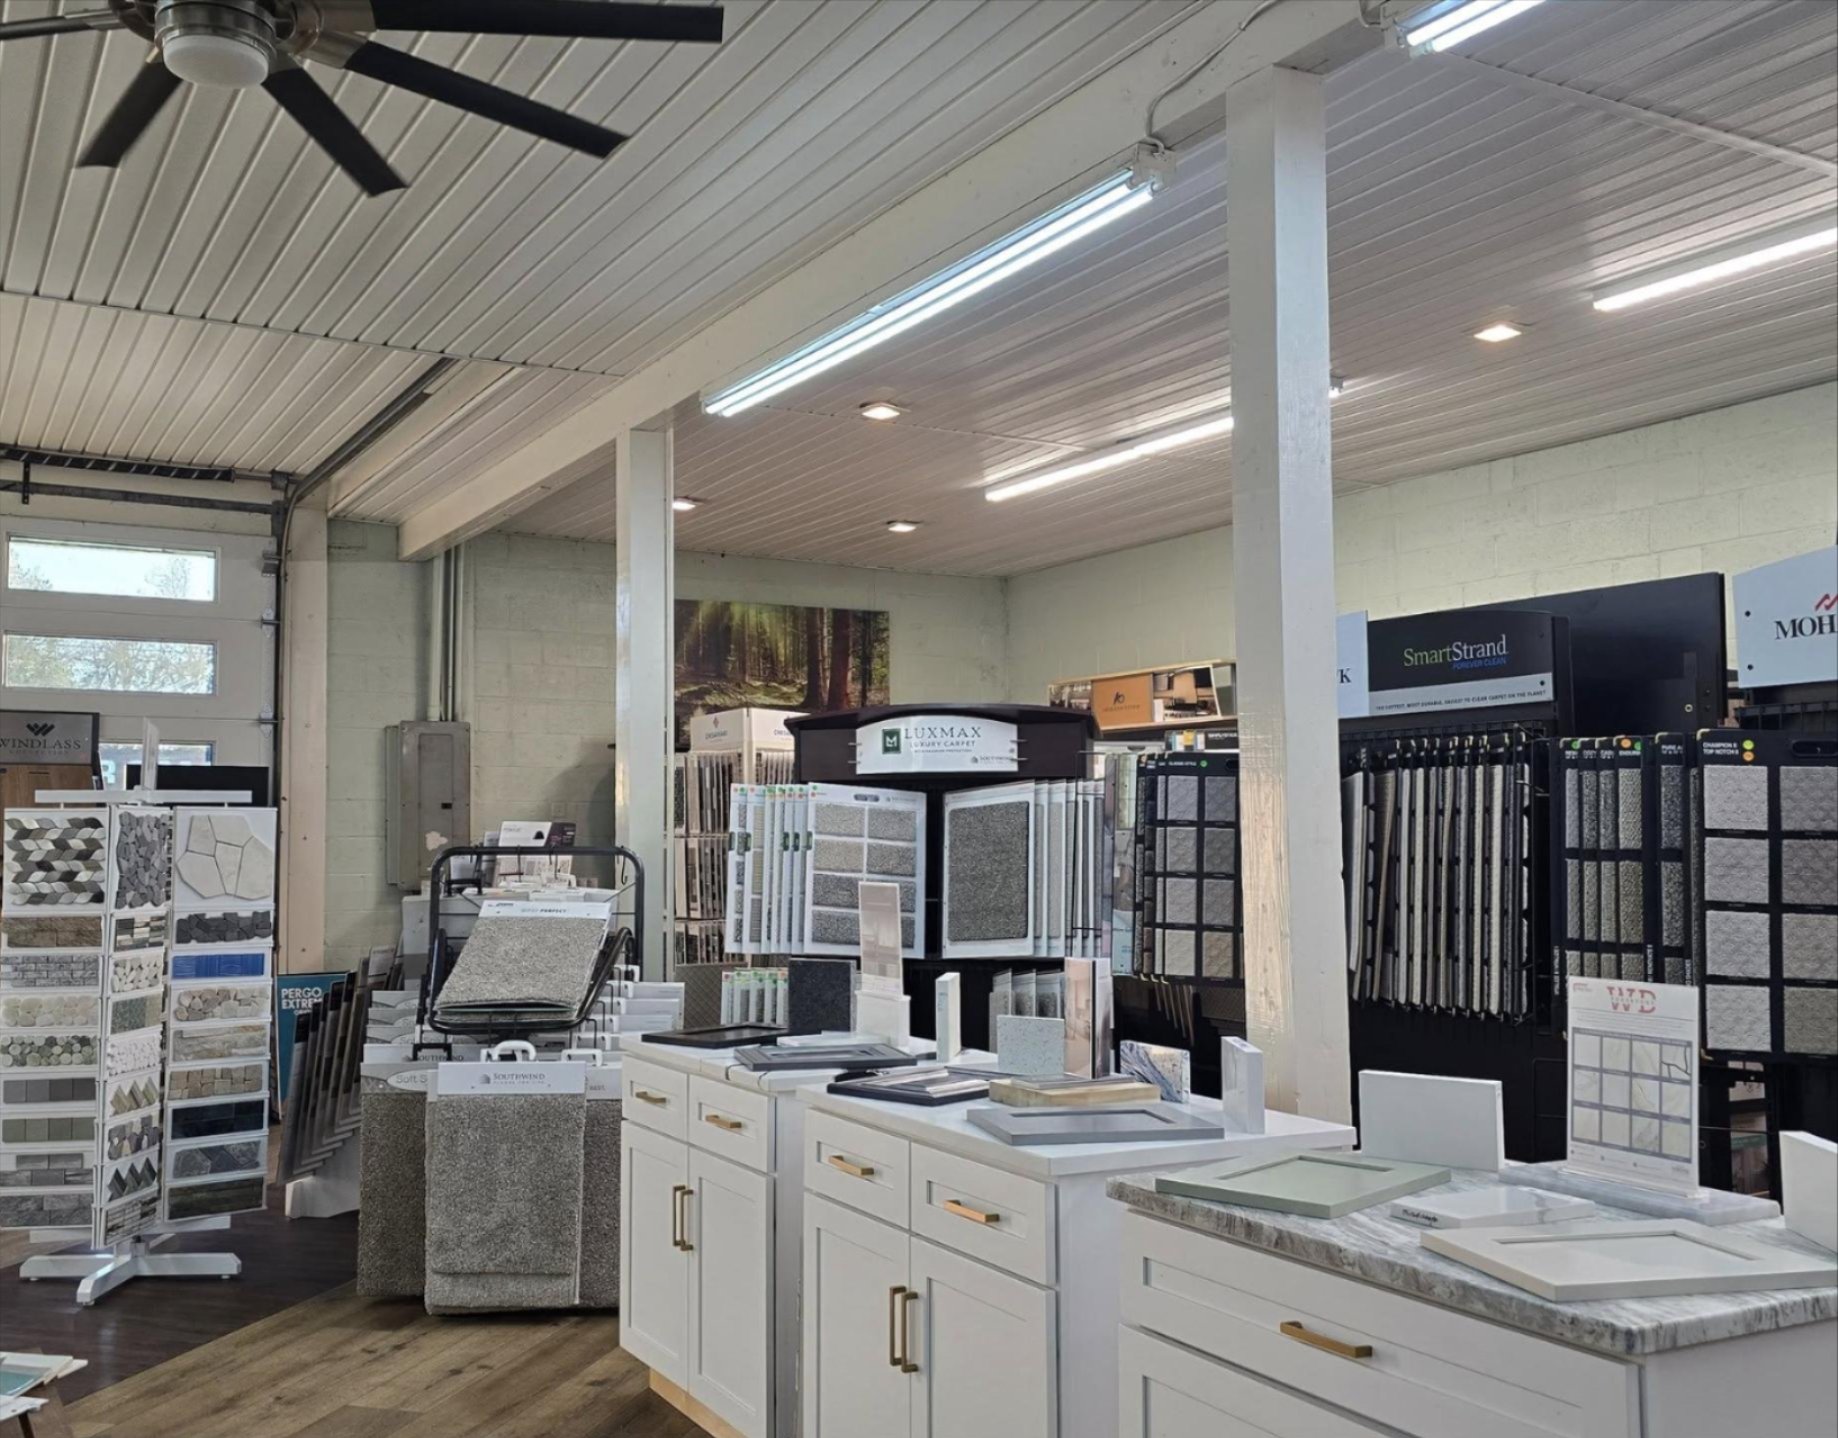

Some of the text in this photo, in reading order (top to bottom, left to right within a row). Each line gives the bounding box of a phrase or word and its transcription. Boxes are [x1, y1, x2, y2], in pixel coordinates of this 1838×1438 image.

[1773, 614, 1838, 640] MOH
[1403, 634, 1509, 667] SmartStrand
[904, 726, 982, 740] LUXMAX
[0, 738, 81, 750] WINDLASS
[944, 740, 976, 748] CARPET
[281, 987, 322, 999] PERGO
[281, 998, 322, 1010] EXTRE
[396, 1075, 417, 1083] Soft
[493, 1073, 545, 1081] SOUTHWIND
